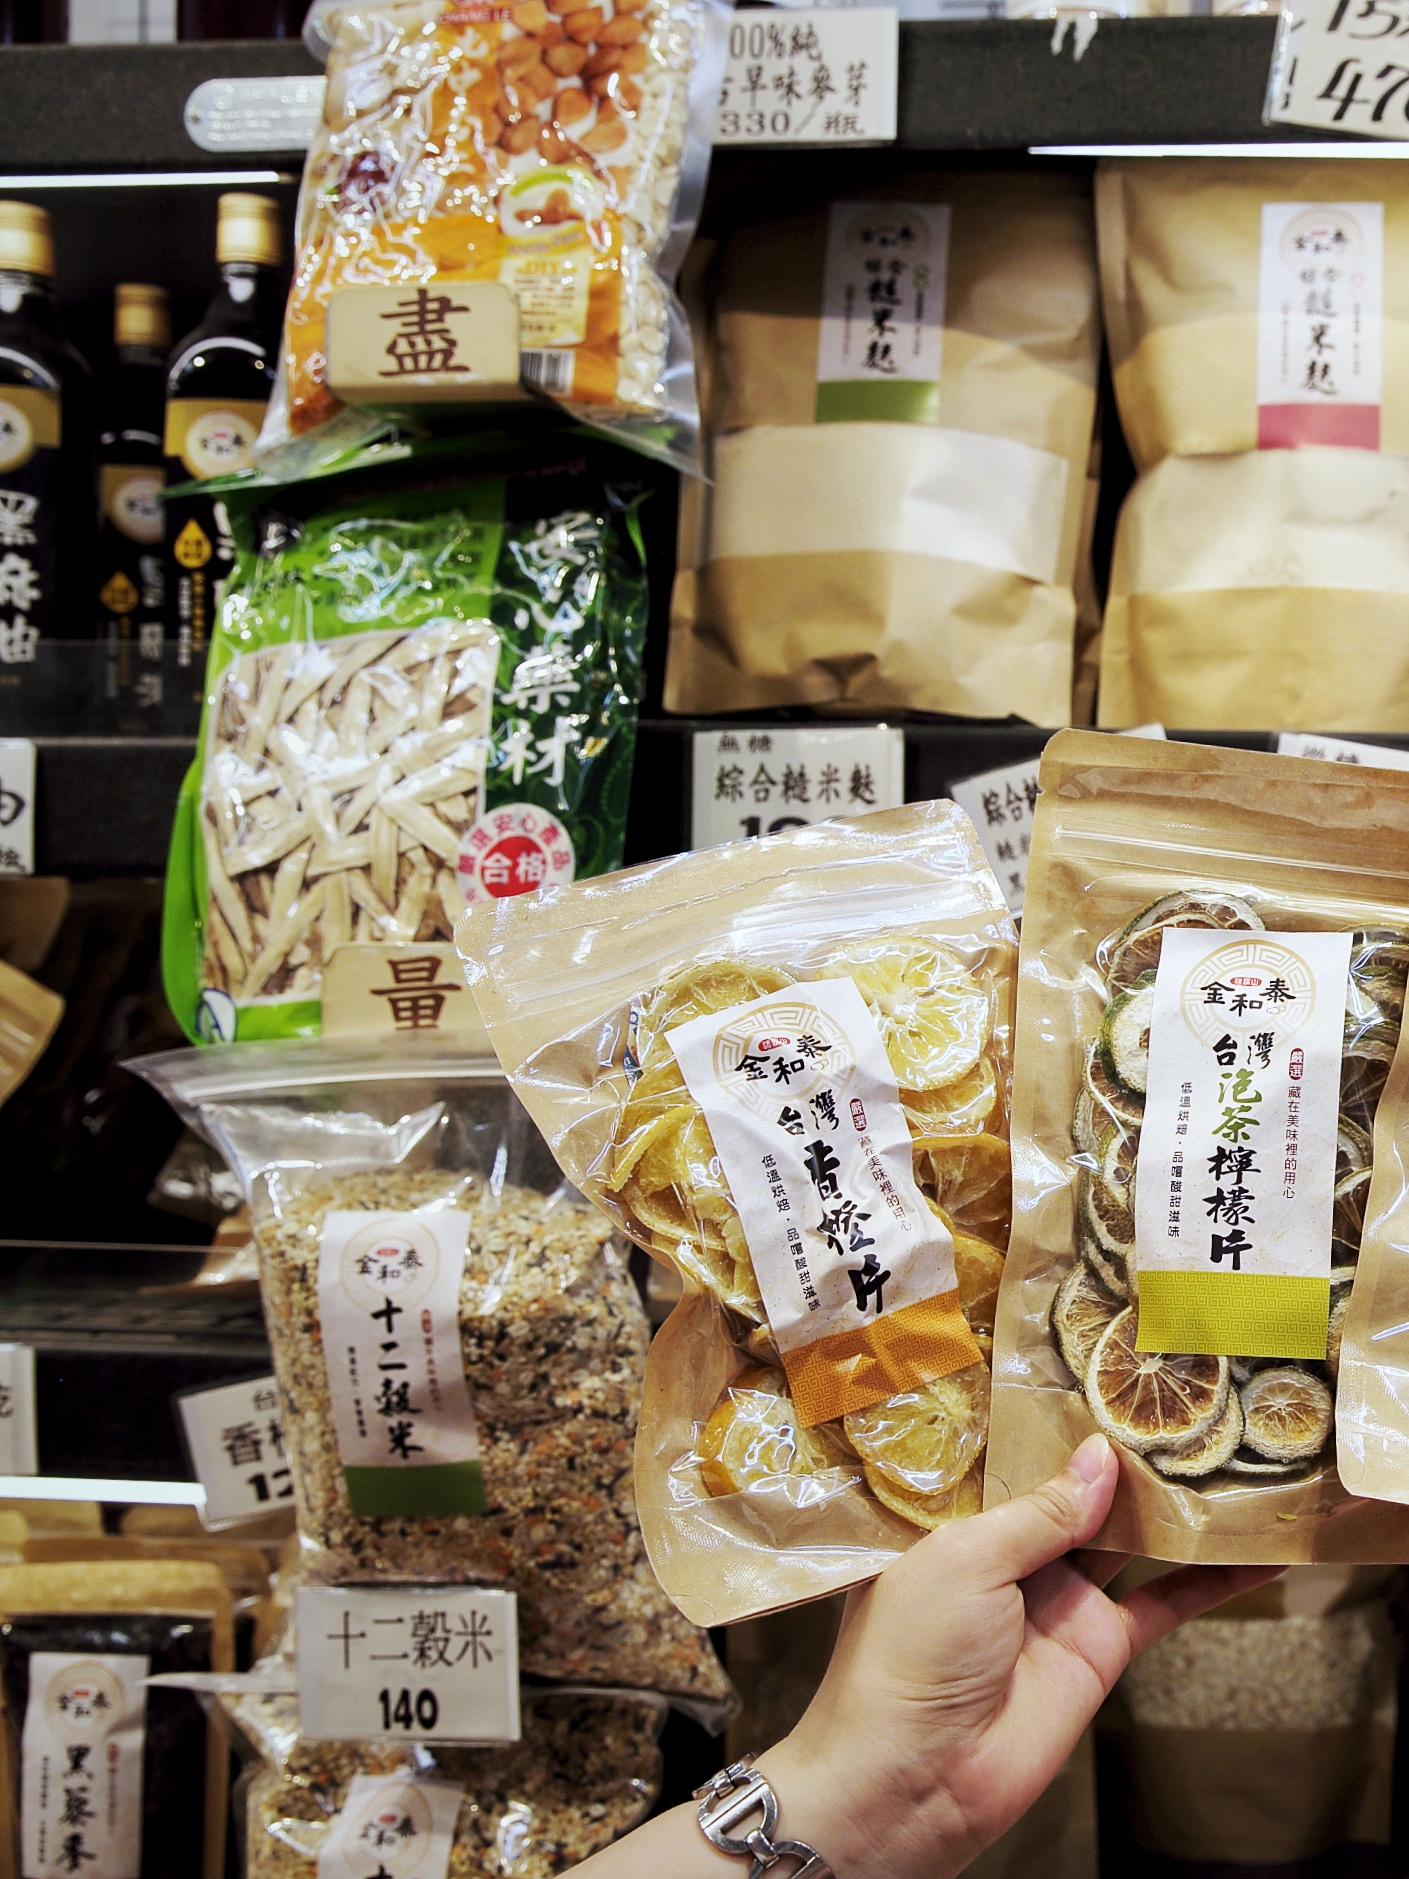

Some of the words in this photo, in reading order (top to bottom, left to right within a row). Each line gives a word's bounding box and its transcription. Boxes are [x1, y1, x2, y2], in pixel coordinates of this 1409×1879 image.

[720, 100, 866, 137] 330/瓶
[379, 288, 471, 377] 盡
[717, 731, 774, 752] 無糖
[714, 762, 878, 804] 綜合糙米麩
[482, 852, 545, 885] 合格
[370, 955, 463, 1030] 量
[1200, 978, 1297, 1017] 金和泰
[735, 1035, 832, 1085] 金和泰
[1212, 1032, 1275, 1070] 台灣
[776, 1089, 839, 1136] 台灣
[1282, 1085, 1302, 1200] 藏在美味裡的用心
[371, 1296, 425, 1460] 十二穀米
[326, 1608, 494, 1669] 十二穀米
[378, 1687, 440, 1731] 140
